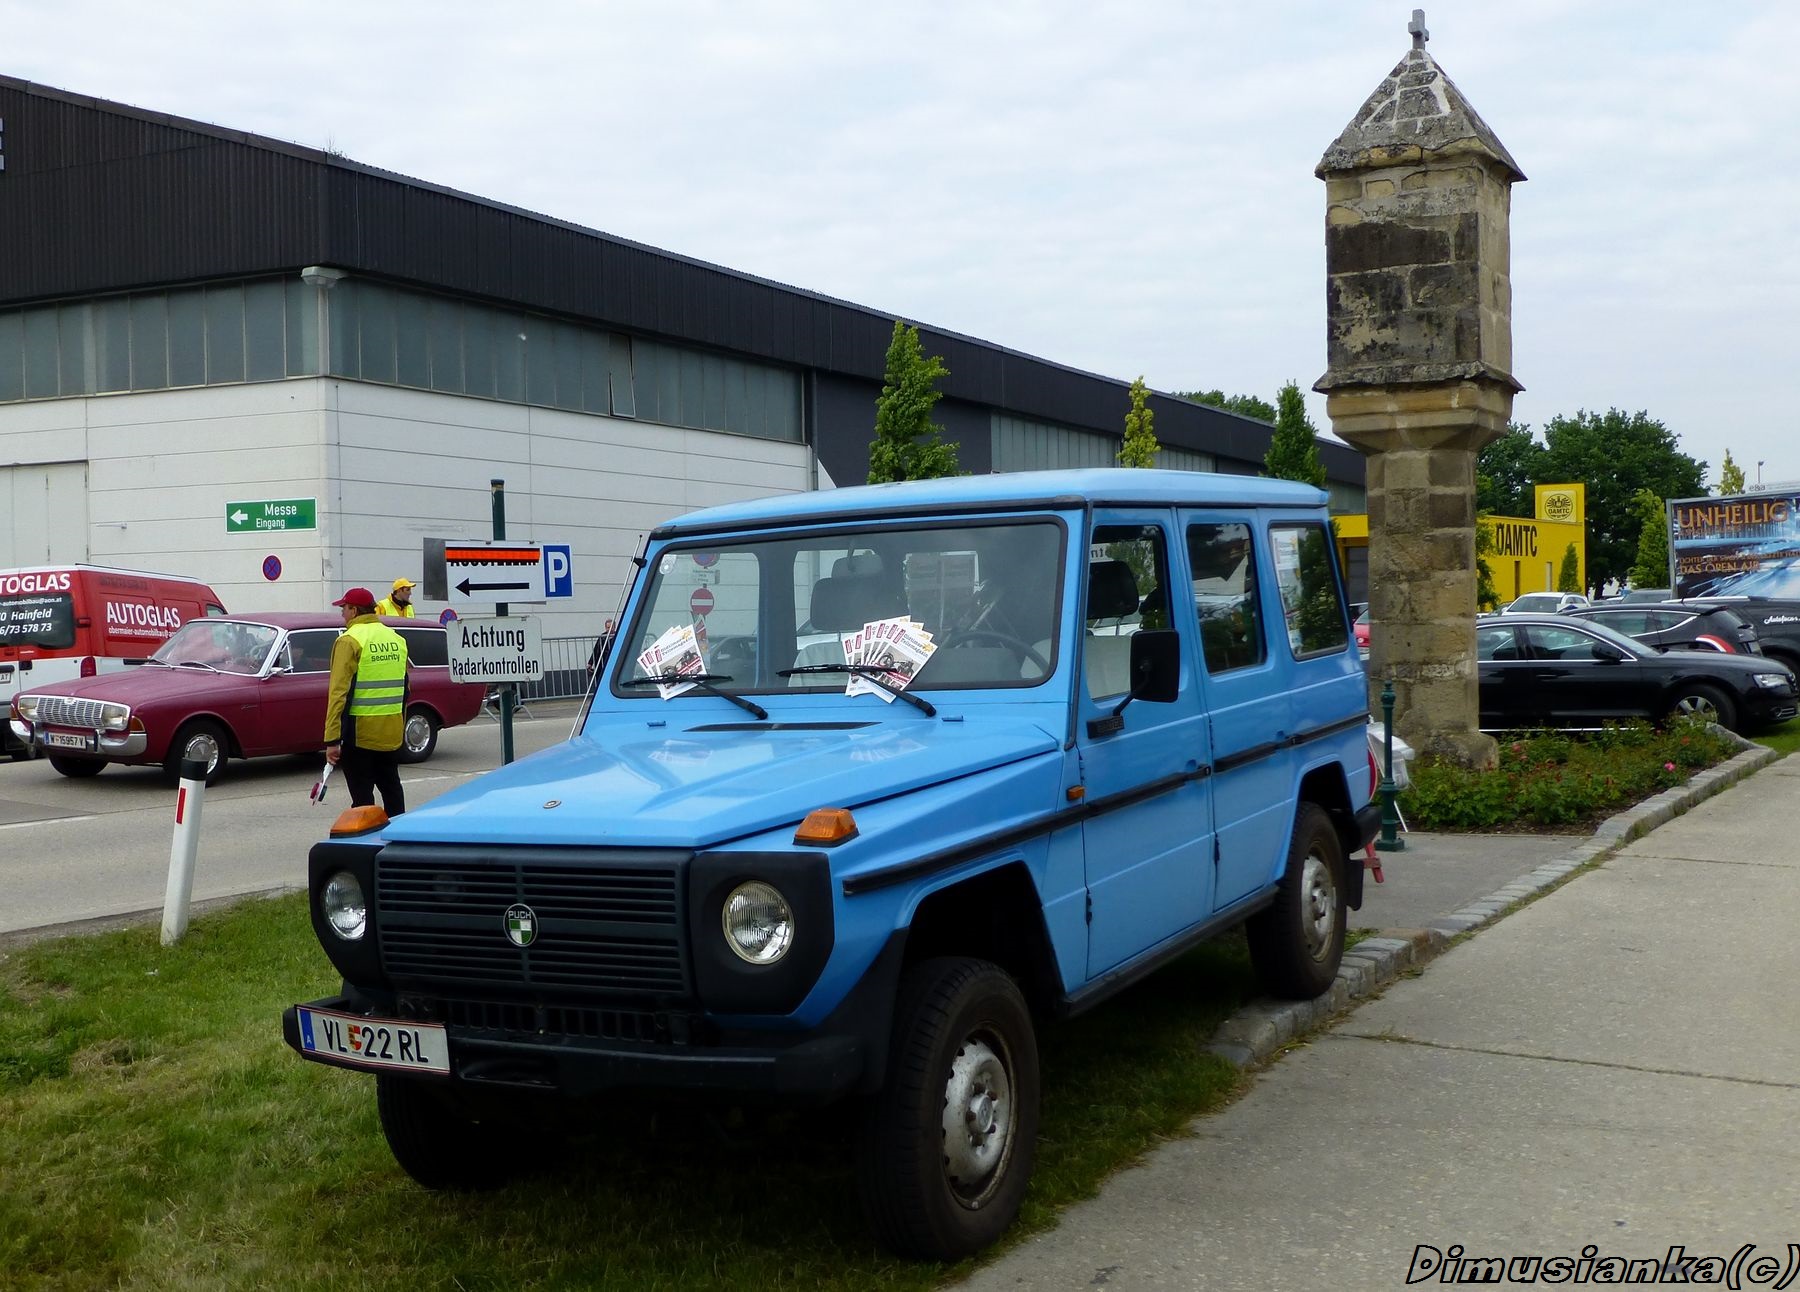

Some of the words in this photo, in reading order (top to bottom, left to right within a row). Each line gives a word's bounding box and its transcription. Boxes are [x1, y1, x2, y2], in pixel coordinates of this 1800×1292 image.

[264, 504, 297, 516] Messe
[1677, 502, 1787, 529] UNHEILIG
[256, 518, 285, 529] Eingang
[547, 551, 569, 593] P
[11, 608, 53, 621] Hainfeld
[106, 601, 181, 628] AUTOGLAS
[22, 623, 39, 633] 578
[41, 623, 52, 632] 73
[461, 624, 525, 652] Achtung
[371, 653, 400, 662] security
[452, 655, 539, 675] Radarkontrollen
[508, 910, 532, 919] PUCH
[322, 1019, 348, 1053] VL
[361, 1026, 393, 1059] 22
[397, 1029, 429, 1063] RL
